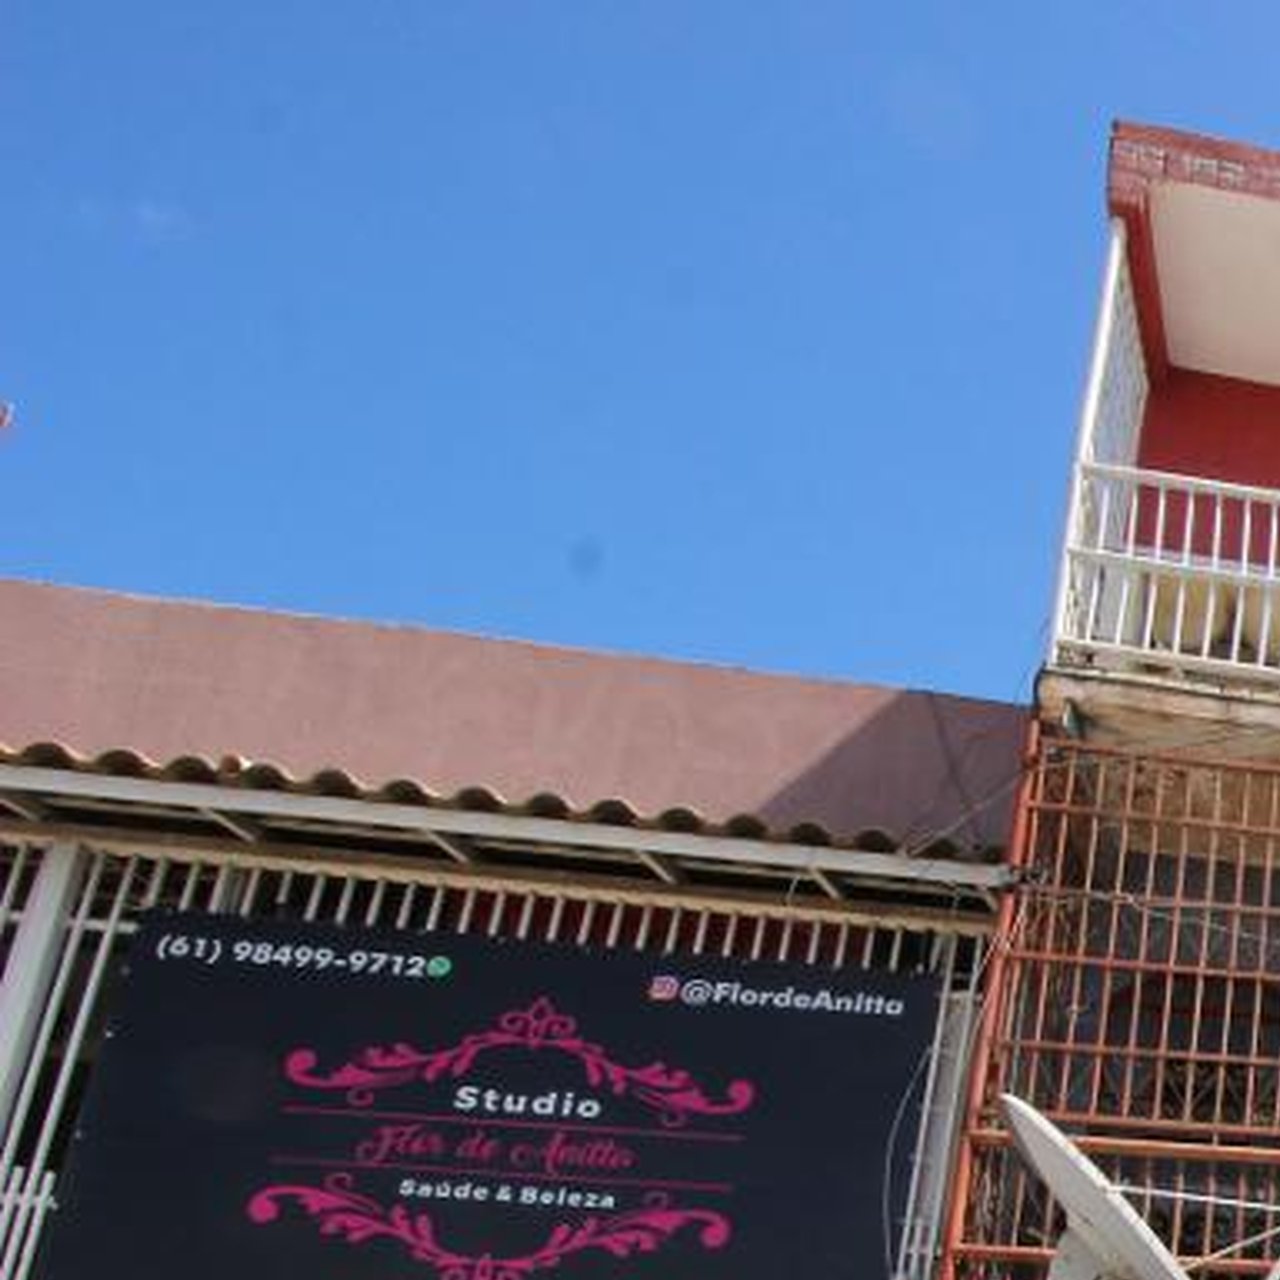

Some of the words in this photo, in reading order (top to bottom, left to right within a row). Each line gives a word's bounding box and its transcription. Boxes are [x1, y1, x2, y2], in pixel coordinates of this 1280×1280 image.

[156, 934, 221, 964] (61)
[233, 941, 426, 976] 98499-9712
[680, 979, 905, 1015] @FlordeAnitta
[453, 1085, 601, 1118] Studio
[399, 1179, 491, 1201] Saúde
[495, 1184, 512, 1201] &
[519, 1186, 616, 1208] Beleza
